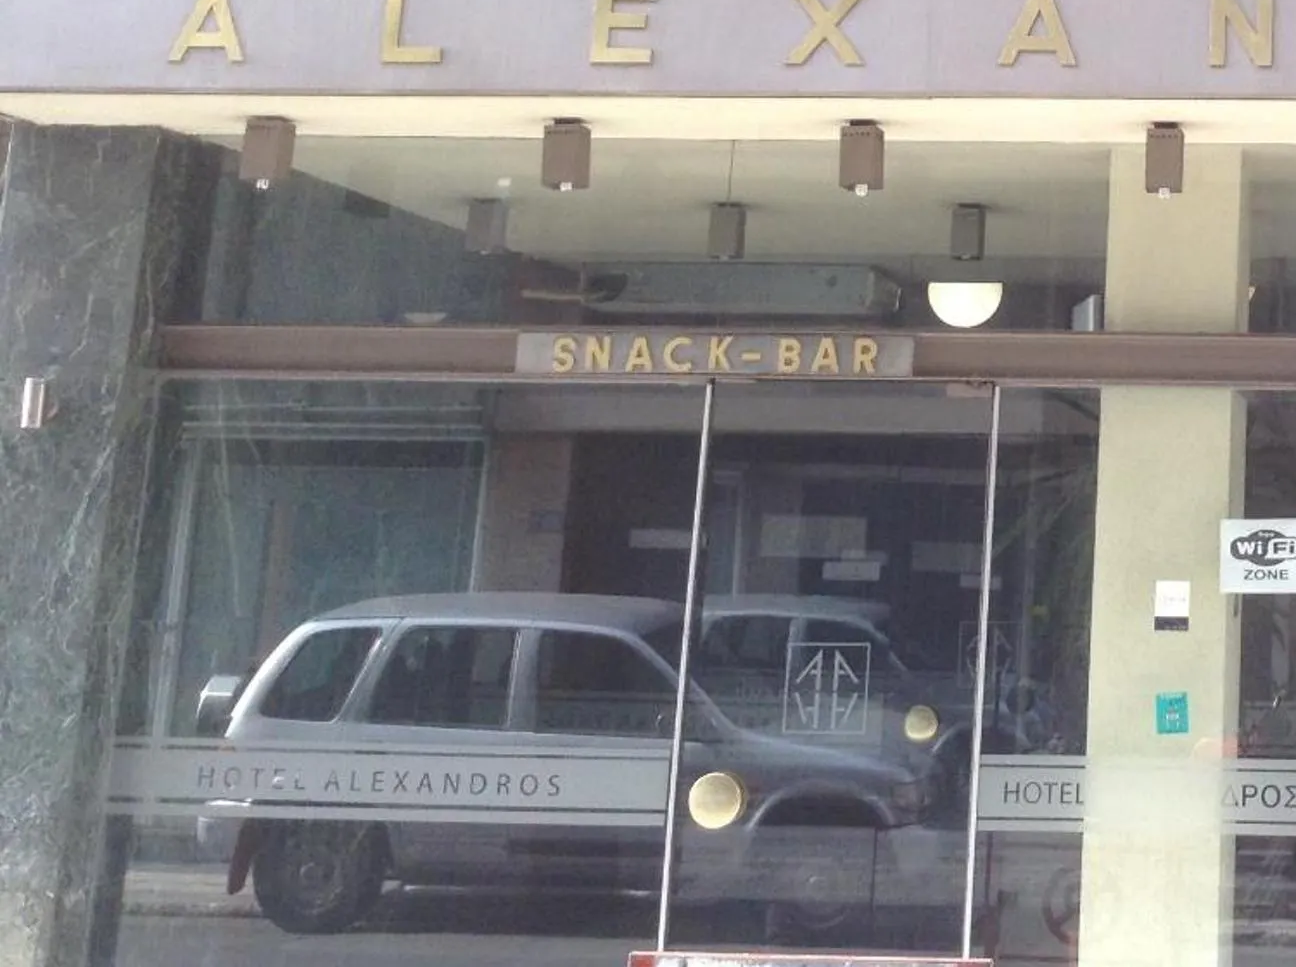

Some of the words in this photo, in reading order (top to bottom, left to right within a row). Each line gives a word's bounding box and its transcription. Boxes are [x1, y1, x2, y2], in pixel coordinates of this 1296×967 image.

[551, 335, 879, 375] SNACK-BAR
[1243, 569, 1290, 581] ZONE
[197, 765, 305, 791] HOTEL
[323, 769, 562, 797] ALEXANDROS
[1002, 780, 1085, 806] HOTEL
